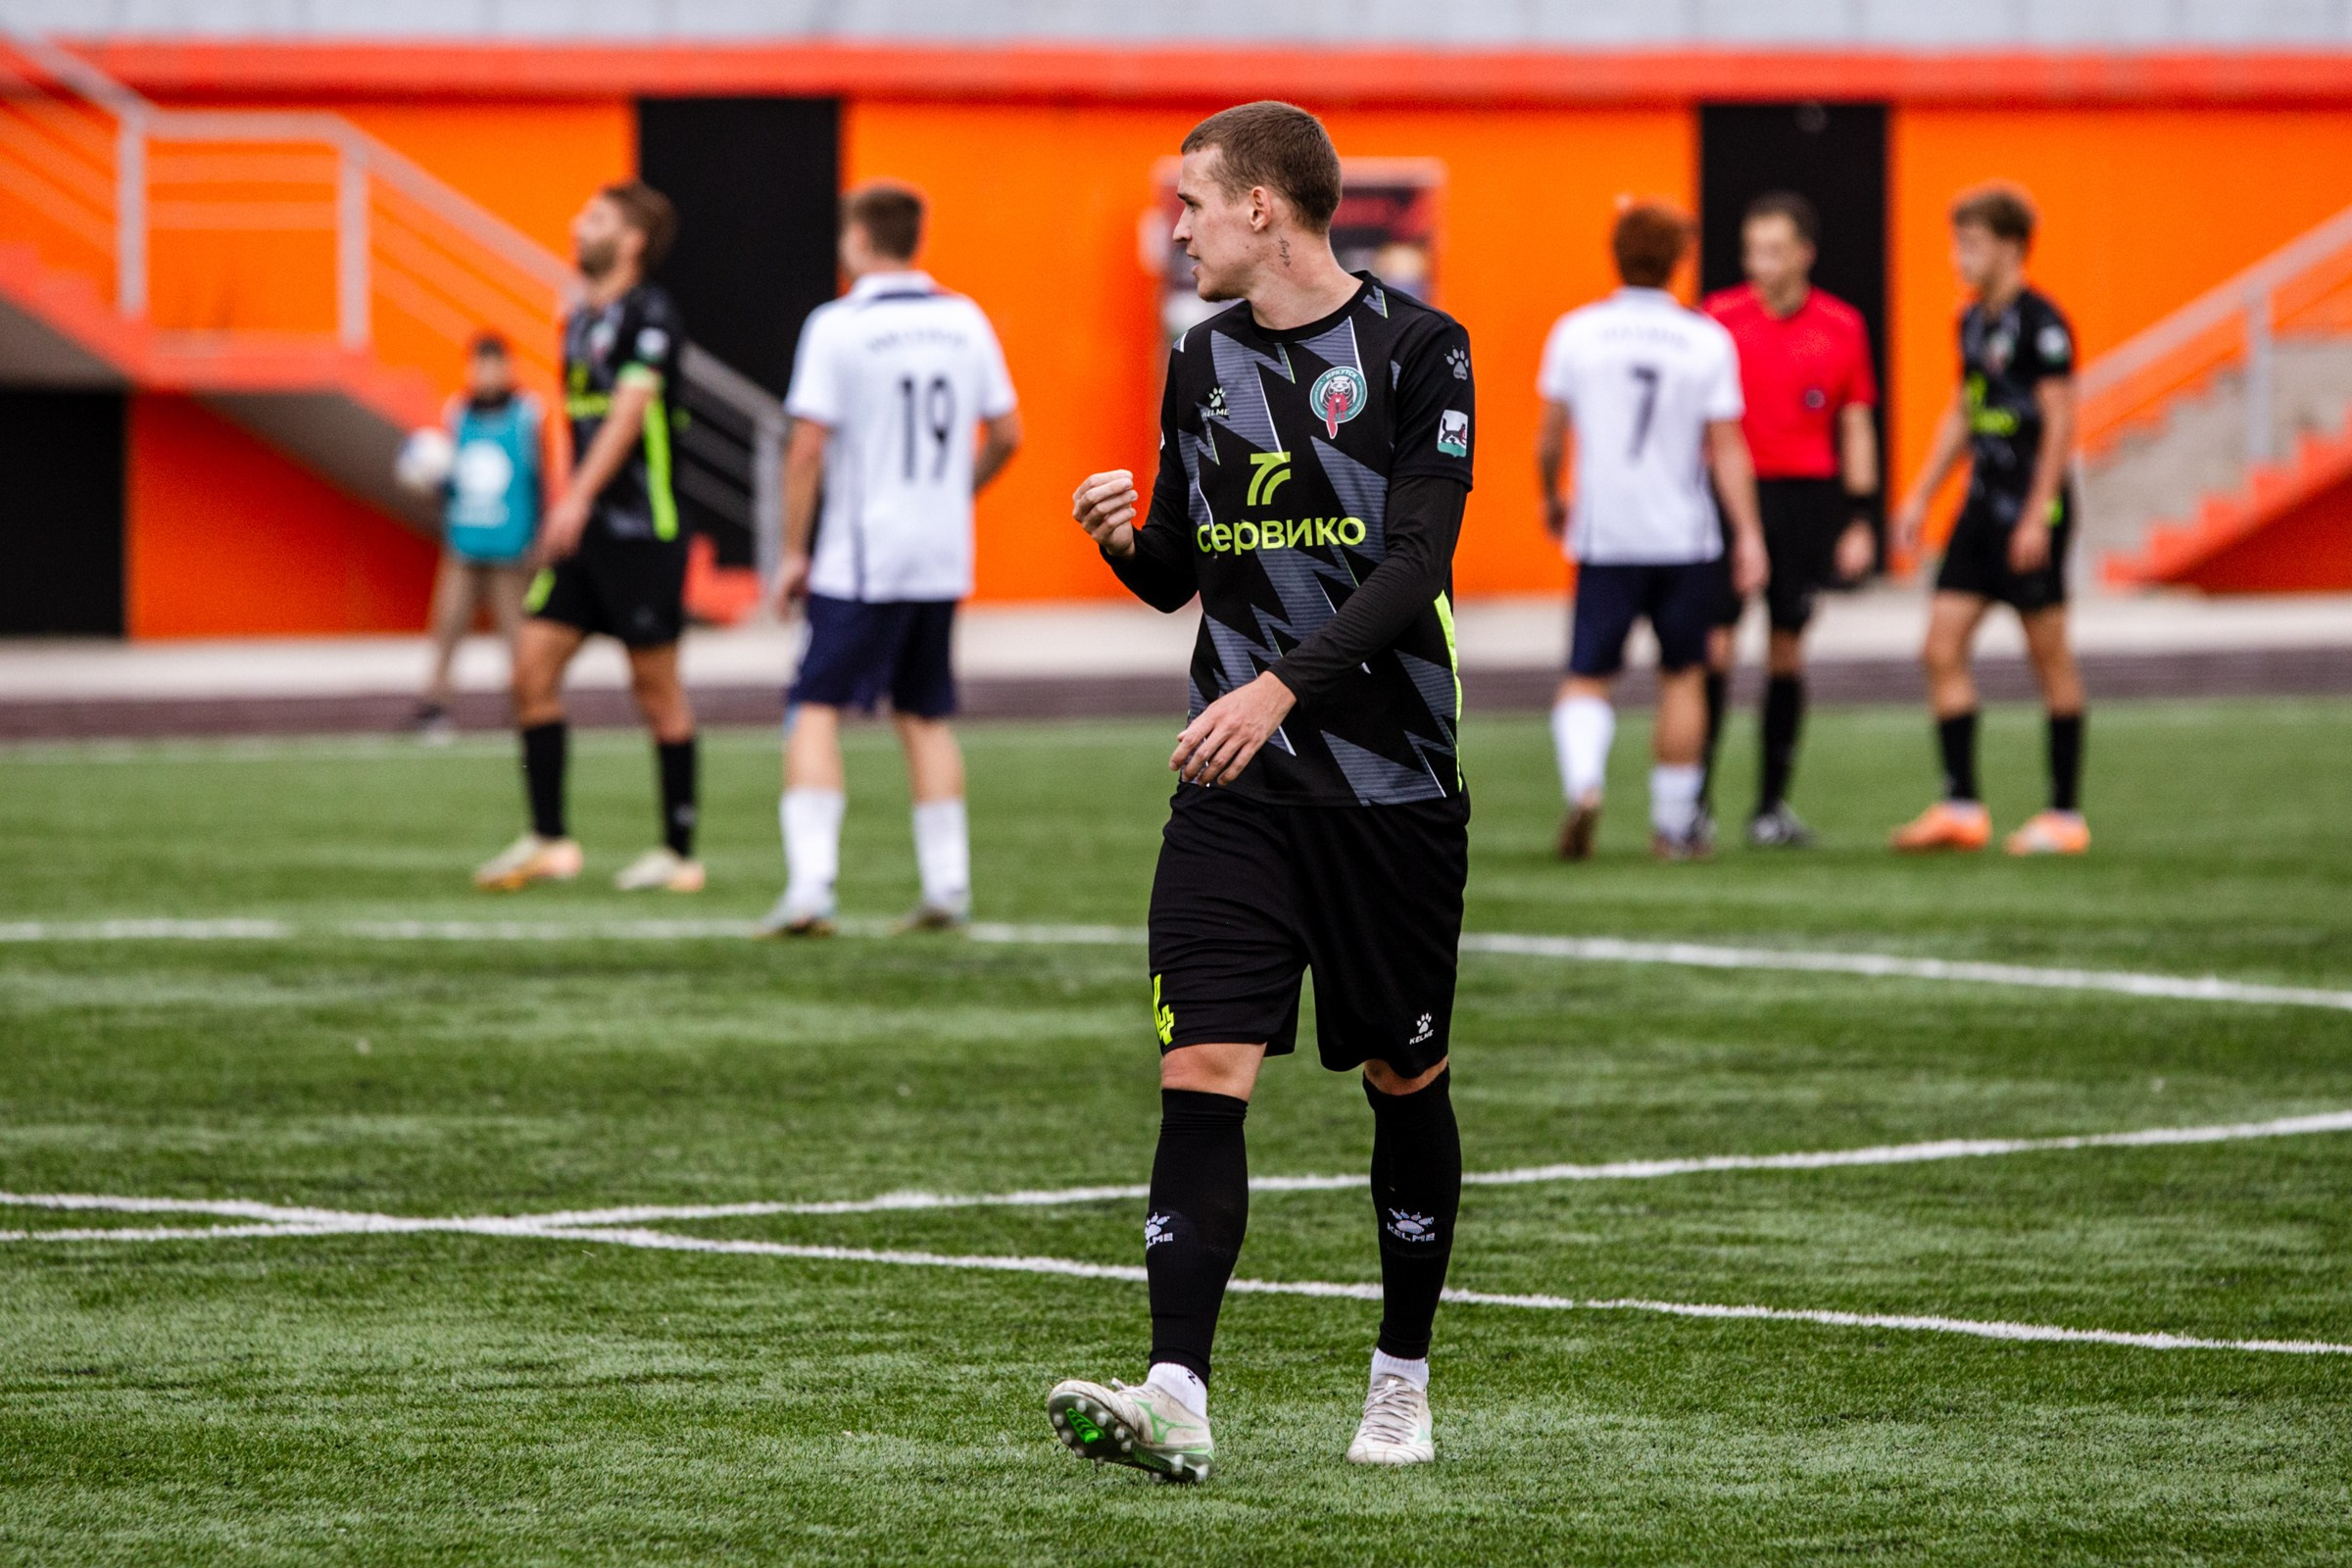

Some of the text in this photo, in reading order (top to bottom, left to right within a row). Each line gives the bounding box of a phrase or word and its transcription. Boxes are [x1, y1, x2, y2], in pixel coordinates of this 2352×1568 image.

[1325, 368, 1358, 379] ИРКУТСК
[900, 373, 956, 484] 19
[1629, 365, 1660, 462] 7
[1197, 516, 1367, 556] сервико
[1409, 1029, 1434, 1046] KELME
[1387, 1222, 1436, 1242] KELME
